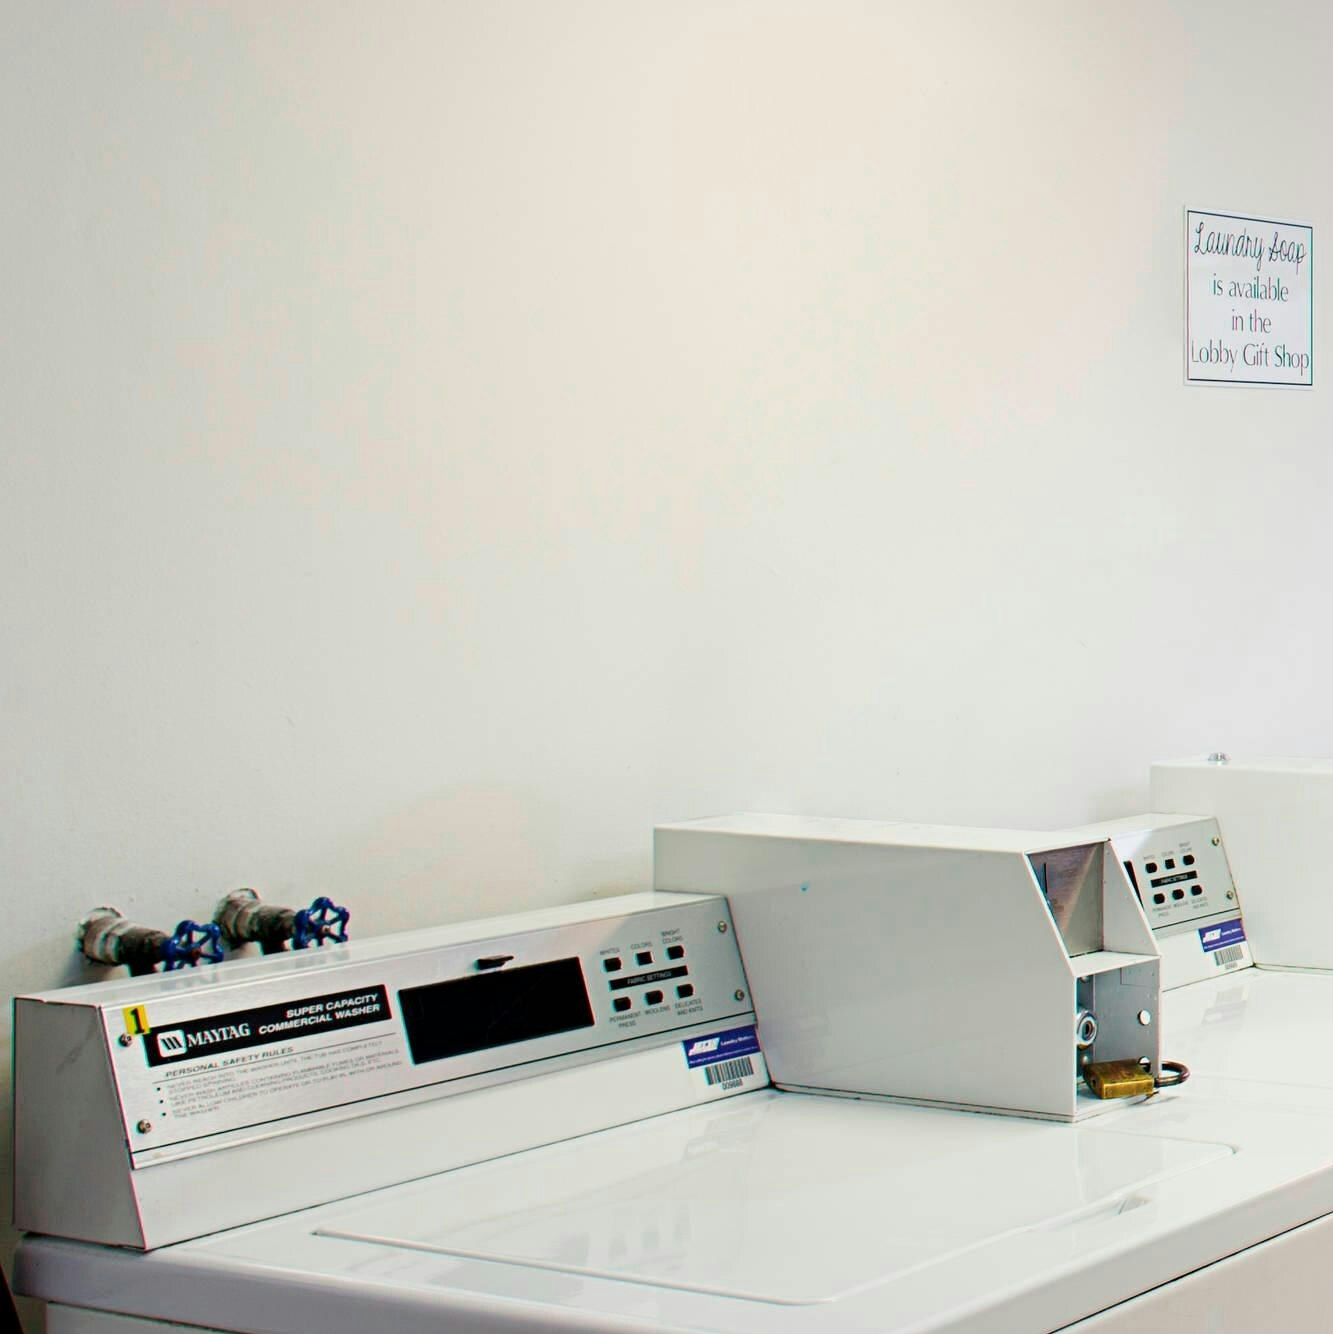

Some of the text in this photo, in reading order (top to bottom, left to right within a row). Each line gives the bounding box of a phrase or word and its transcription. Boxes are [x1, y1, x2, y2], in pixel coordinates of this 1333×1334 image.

[1194, 221, 1307, 275] Laundry Soap
[1213, 273, 1289, 302] is available
[1232, 309, 1272, 333] in the
[1191, 339, 1310, 376] Lobby Gift Shop
[258, 1003, 381, 1035] COMMERCIAL WASHER
[286, 993, 379, 1018] SUPER CAPACITY
[130, 1007, 145, 1034] 1
[187, 1022, 251, 1048] MAYTAG
[165, 1046, 294, 1078] PERSONAL SAFETY RULES
